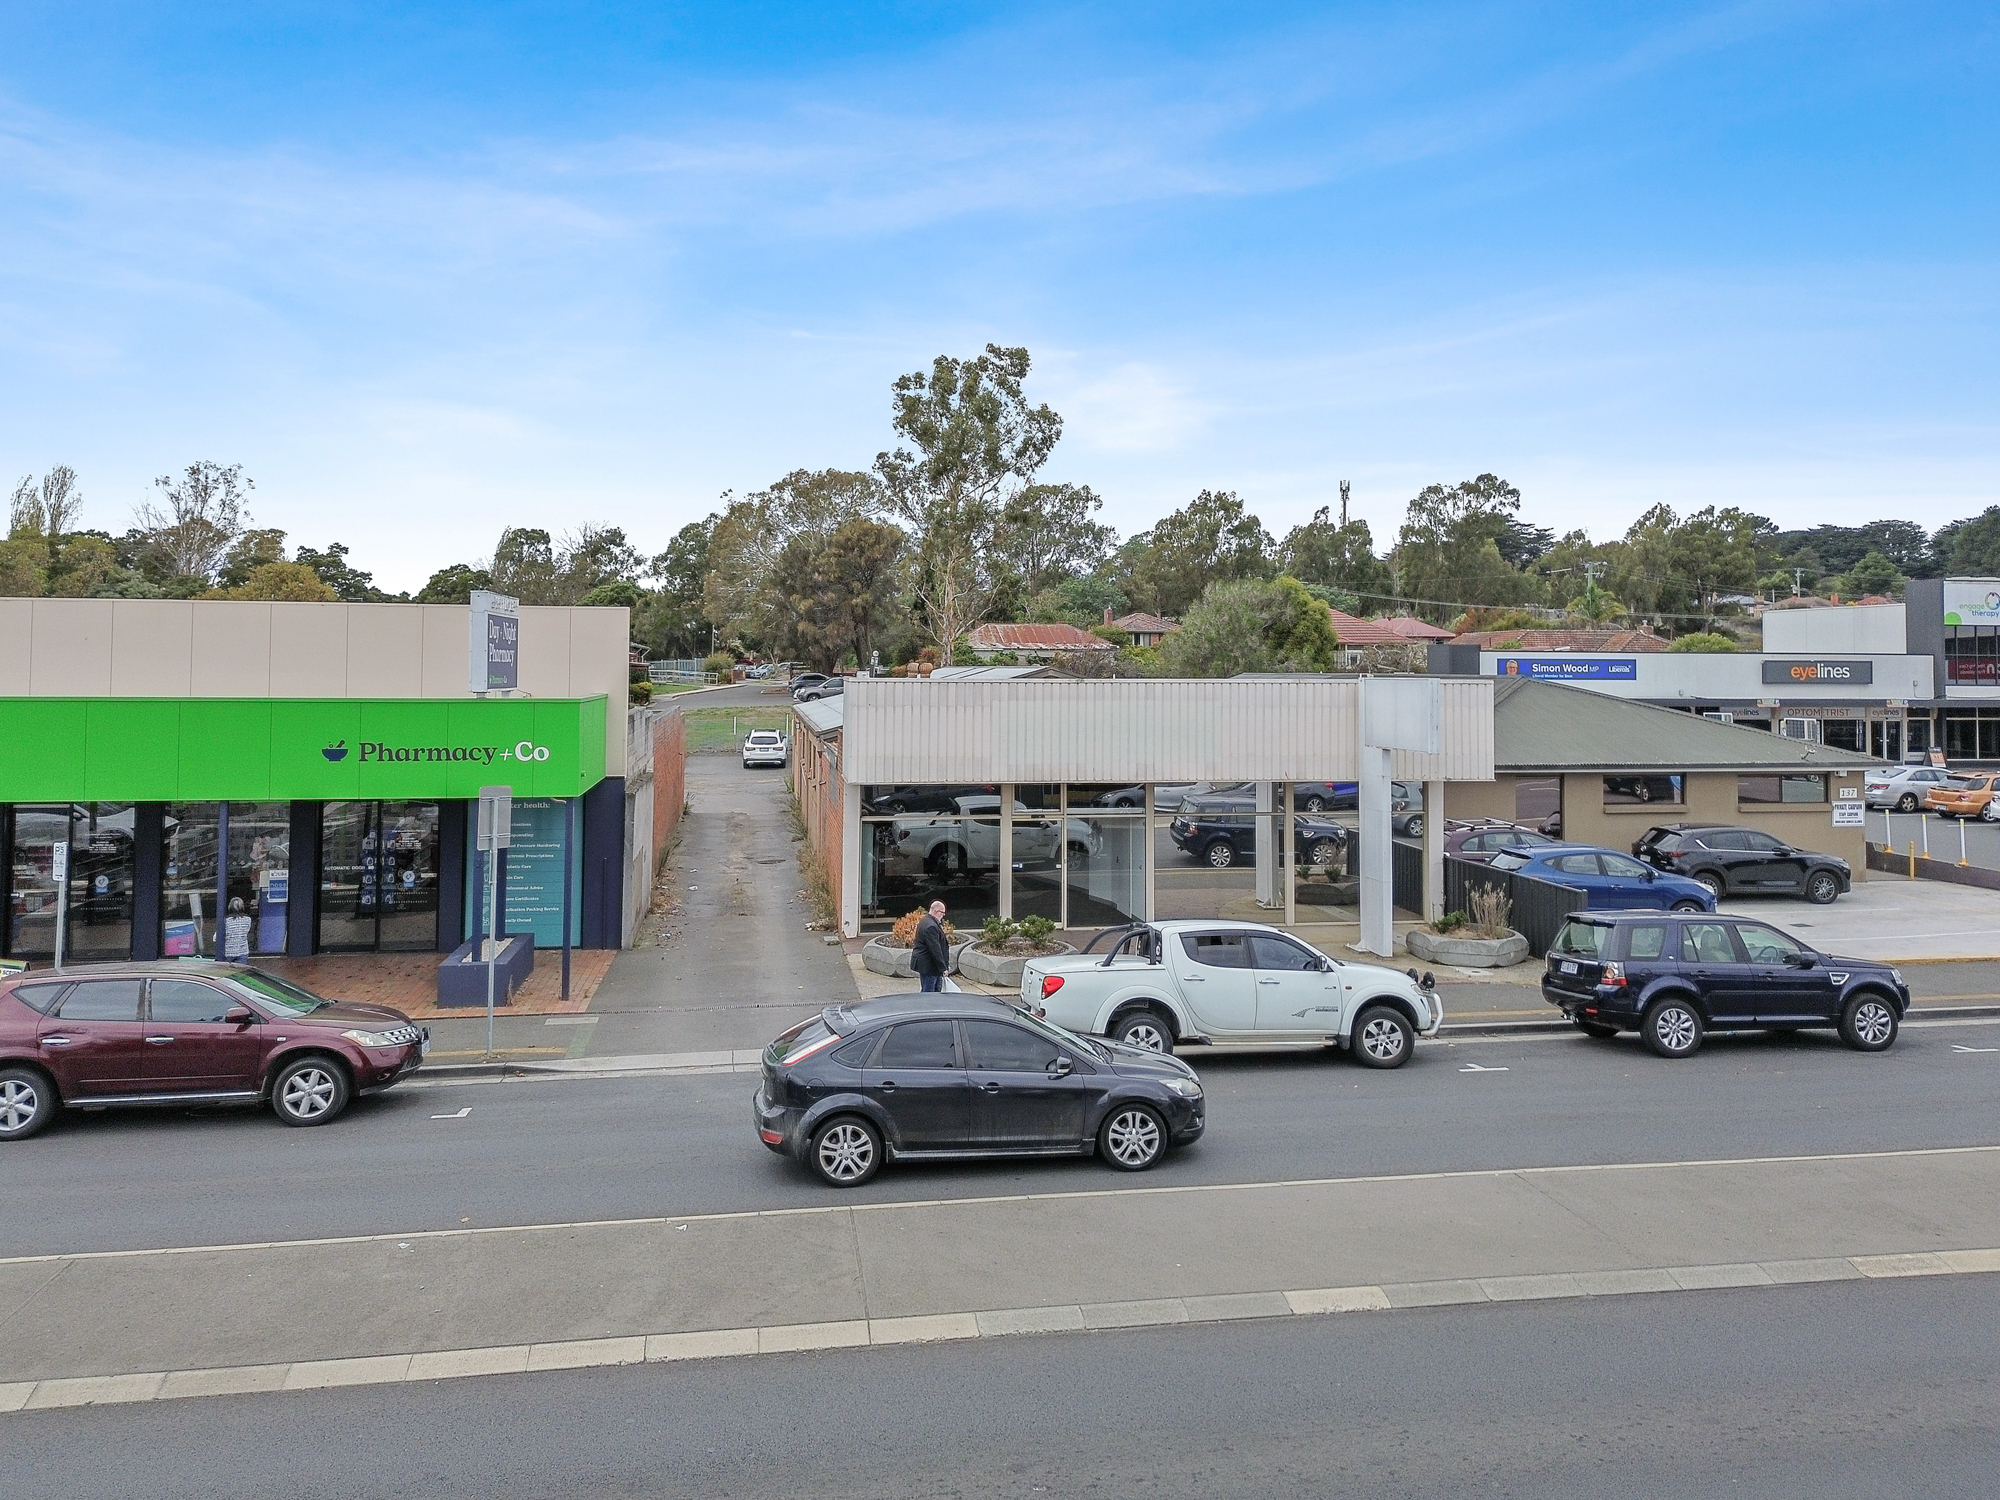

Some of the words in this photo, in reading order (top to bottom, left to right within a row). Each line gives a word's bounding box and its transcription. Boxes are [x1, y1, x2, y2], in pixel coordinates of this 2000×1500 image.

[1959, 603, 1985, 611] engage
[503, 621, 517, 645] Night
[489, 643, 515, 667] Pharmacy
[1532, 663, 1560, 673] Simon
[1563, 663, 1588, 673] Wood
[1791, 663, 1850, 681] eyelines
[1732, 708, 1760, 717] eyelines
[1872, 708, 1900, 717] eyelines
